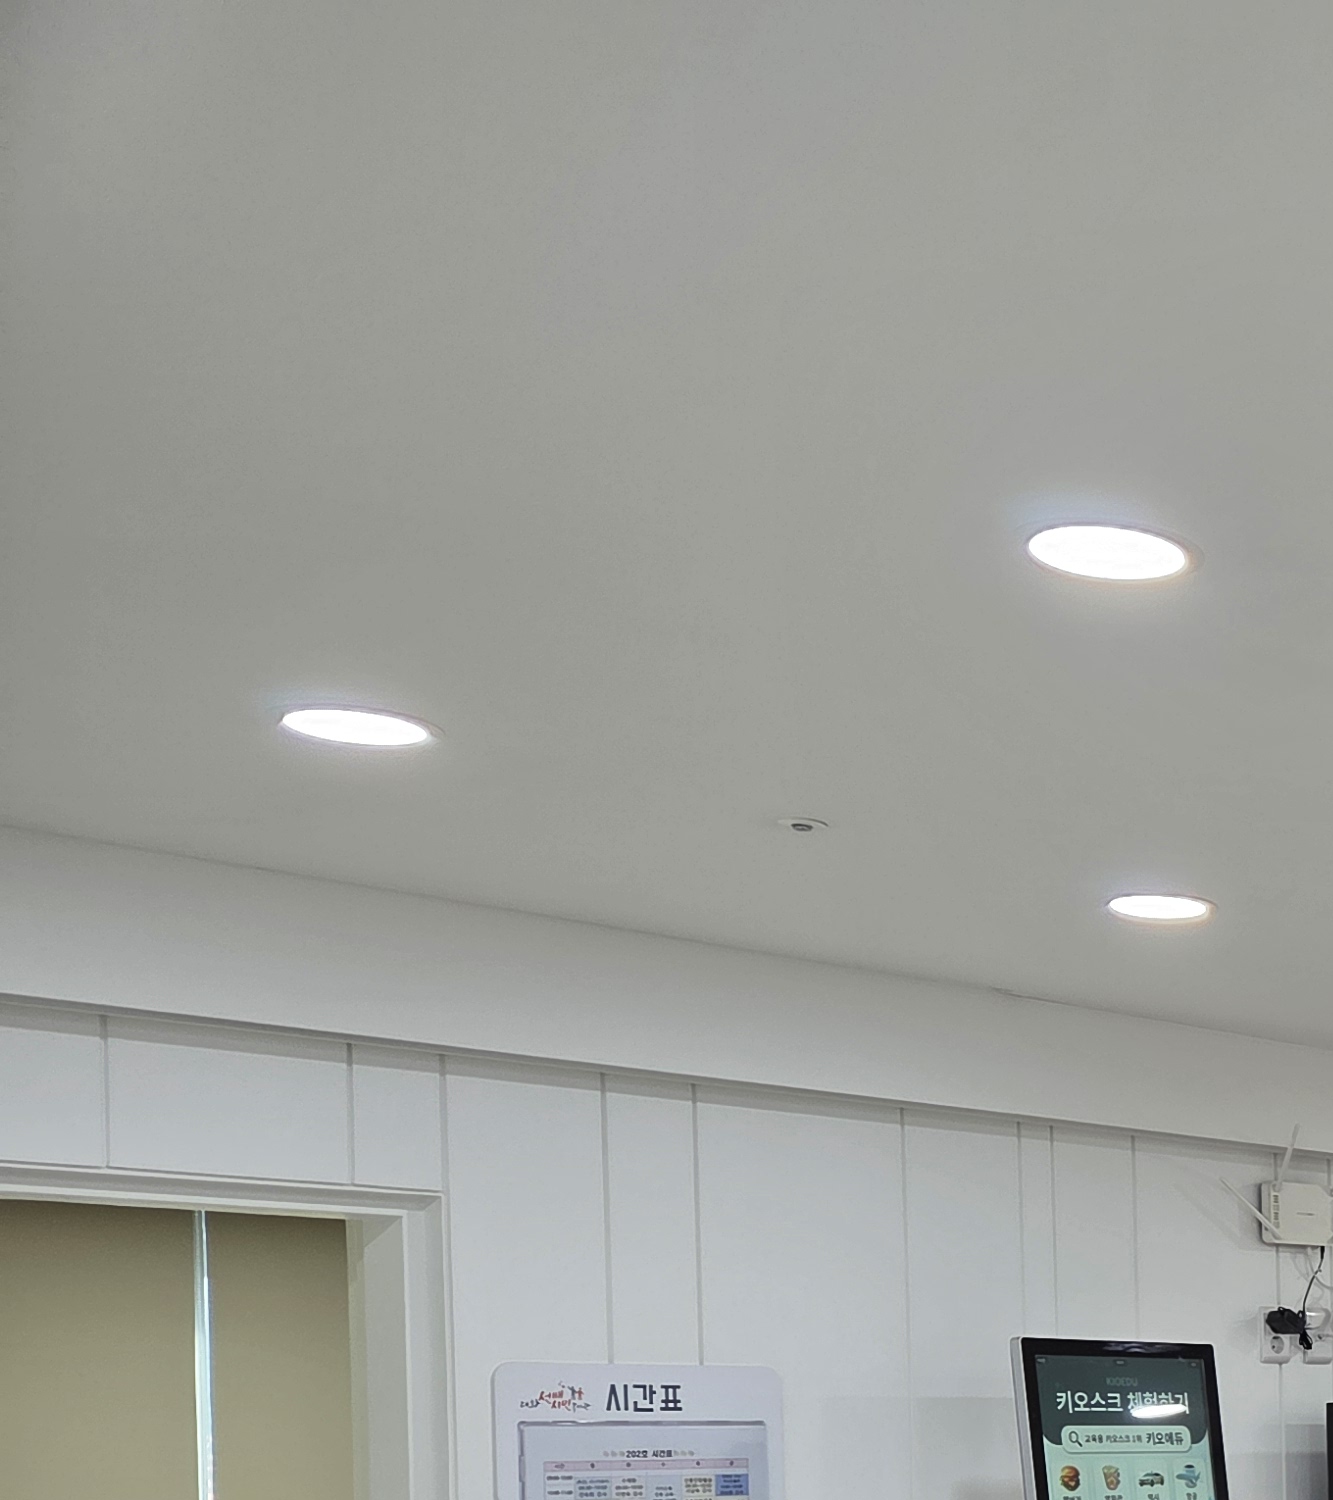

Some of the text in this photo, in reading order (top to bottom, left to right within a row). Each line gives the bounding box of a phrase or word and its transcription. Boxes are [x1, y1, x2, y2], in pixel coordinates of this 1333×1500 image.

[606, 1384, 683, 1413] 시간표
[1056, 1390, 1124, 1414] 키오스크
[1106, 1433, 1131, 1444] 키오스크
[1146, 1431, 1184, 1446] 키오에듀
[625, 1449, 674, 1459] 202호 시간표
